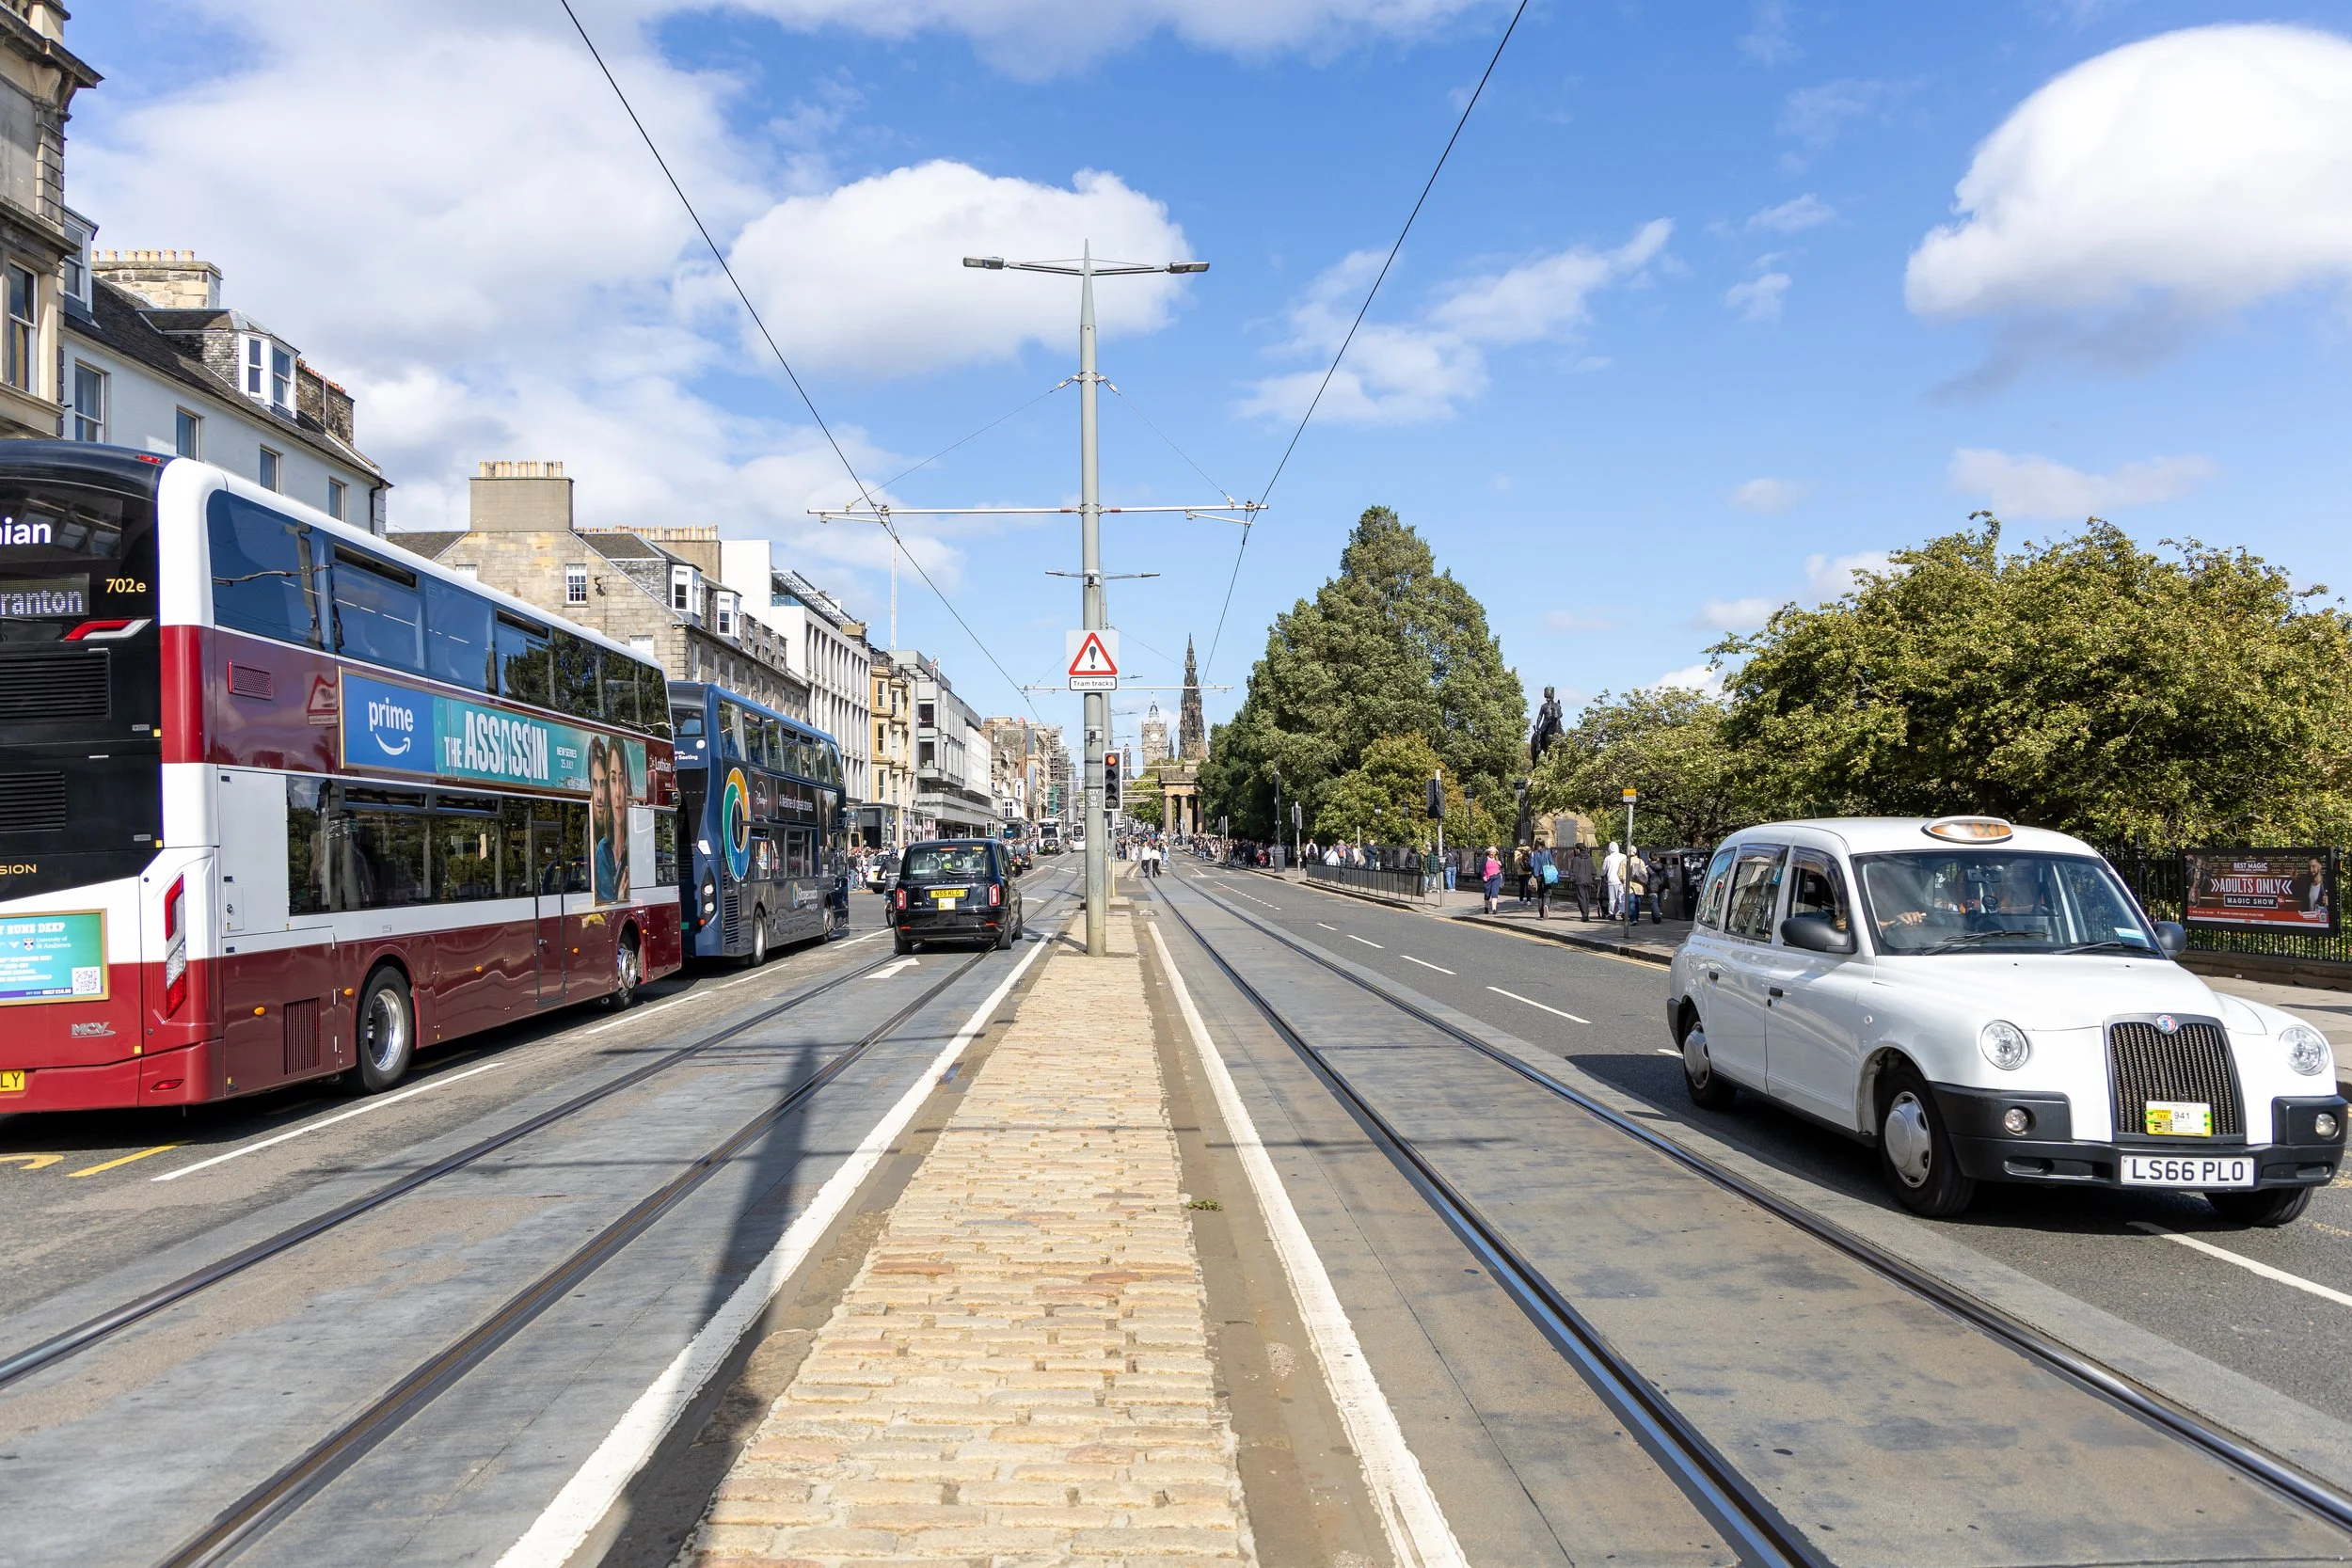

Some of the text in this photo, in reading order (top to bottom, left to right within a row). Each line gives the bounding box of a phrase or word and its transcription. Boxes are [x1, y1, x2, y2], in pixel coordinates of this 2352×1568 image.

[105, 578, 147, 594] 702e
[368, 697, 414, 733] prime
[444, 710, 548, 781] THE ASSASSIN
[557, 746, 578, 759] NEW SERIES
[561, 759, 574, 770] 25 JULY
[655, 756, 672, 773] Lothian
[2219, 878, 2281, 895] ADULTS ONLY
[7, 924, 36, 935] RUNS
[38, 922, 66, 933] DEEP
[71, 1022, 111, 1037] MCV
[0, 1073, 20, 1087] LY
[2174, 1111, 2190, 1119] 941
[2132, 1158, 2244, 1181] LS66 PLO
